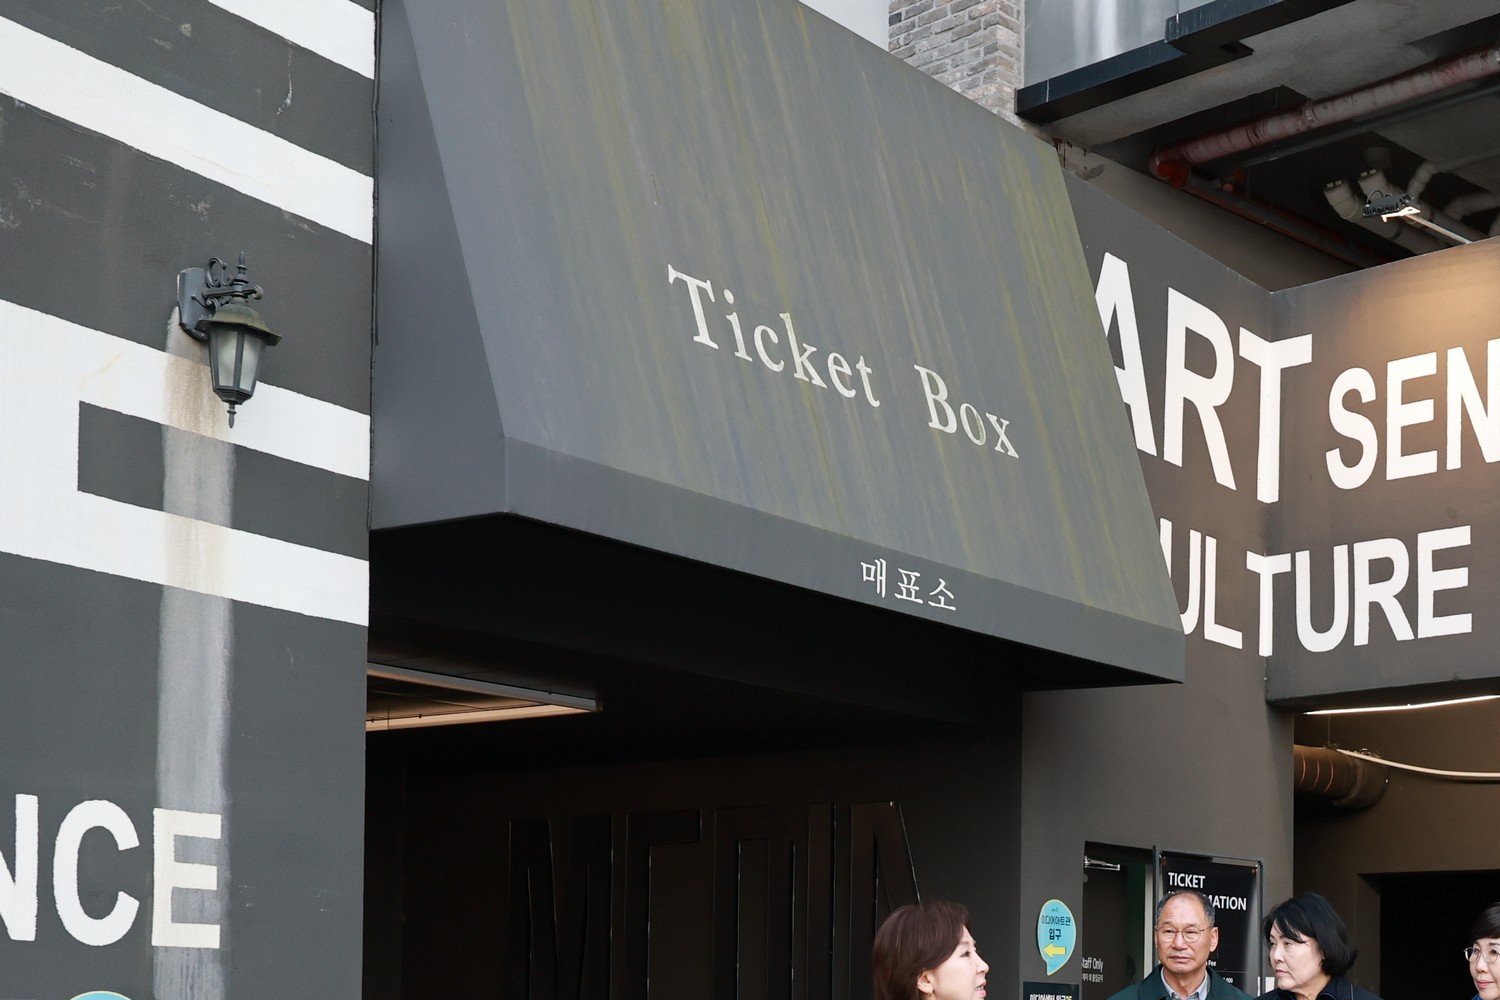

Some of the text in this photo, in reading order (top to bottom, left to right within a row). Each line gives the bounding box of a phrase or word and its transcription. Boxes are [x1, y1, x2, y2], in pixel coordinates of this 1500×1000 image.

[668, 264, 1019, 459] Ticket Box
[1095, 252, 1312, 503] ART
[860, 558, 956, 611] 매표소
[1160, 518, 1472, 657] ULTURE
[1168, 872, 1205, 889] TICKET
[1042, 915, 1071, 926] 미디어아트관
[1049, 928, 1061, 940] 입구
[1082, 957, 1103, 973] taff Only
